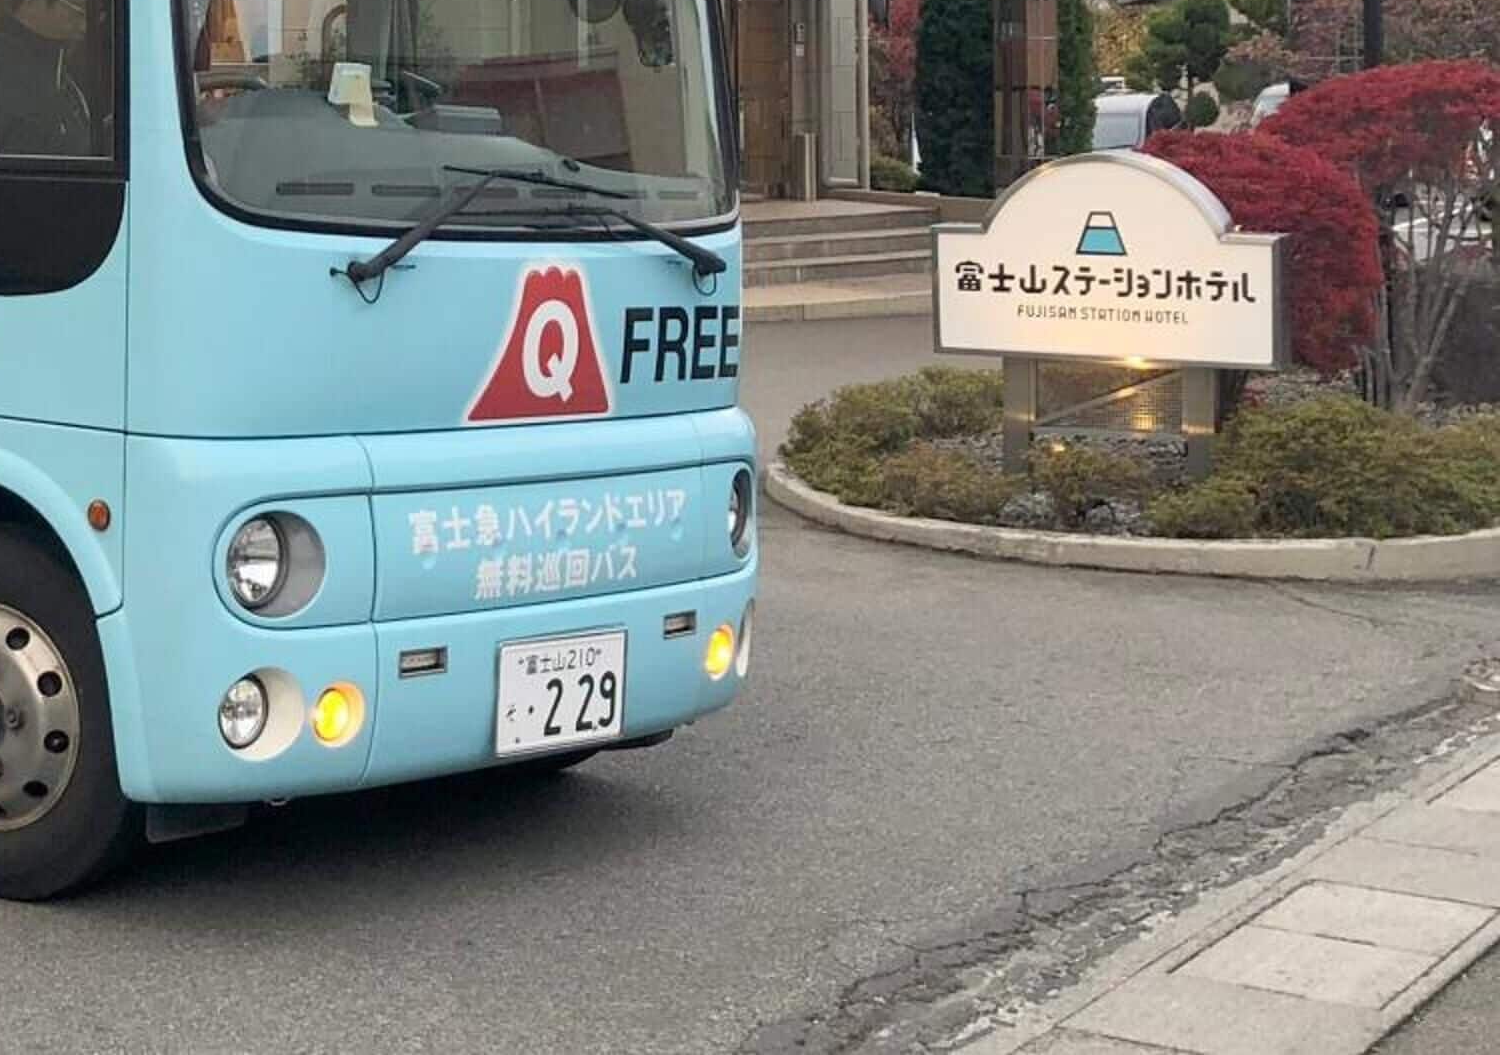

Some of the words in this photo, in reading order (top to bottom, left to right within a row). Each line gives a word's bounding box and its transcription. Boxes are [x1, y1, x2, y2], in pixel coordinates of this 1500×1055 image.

[954, 260, 1257, 304] 富士山ステーションホテル
[1016, 303, 1078, 320] FUJISAN
[1079, 306, 1142, 323] STATION
[1144, 309, 1189, 325] HOTEL
[521, 298, 580, 402] Q
[619, 304, 740, 384] FREE
[408, 488, 686, 556] 富士急ハイランドエリア
[474, 545, 638, 601] 無料巡回バス
